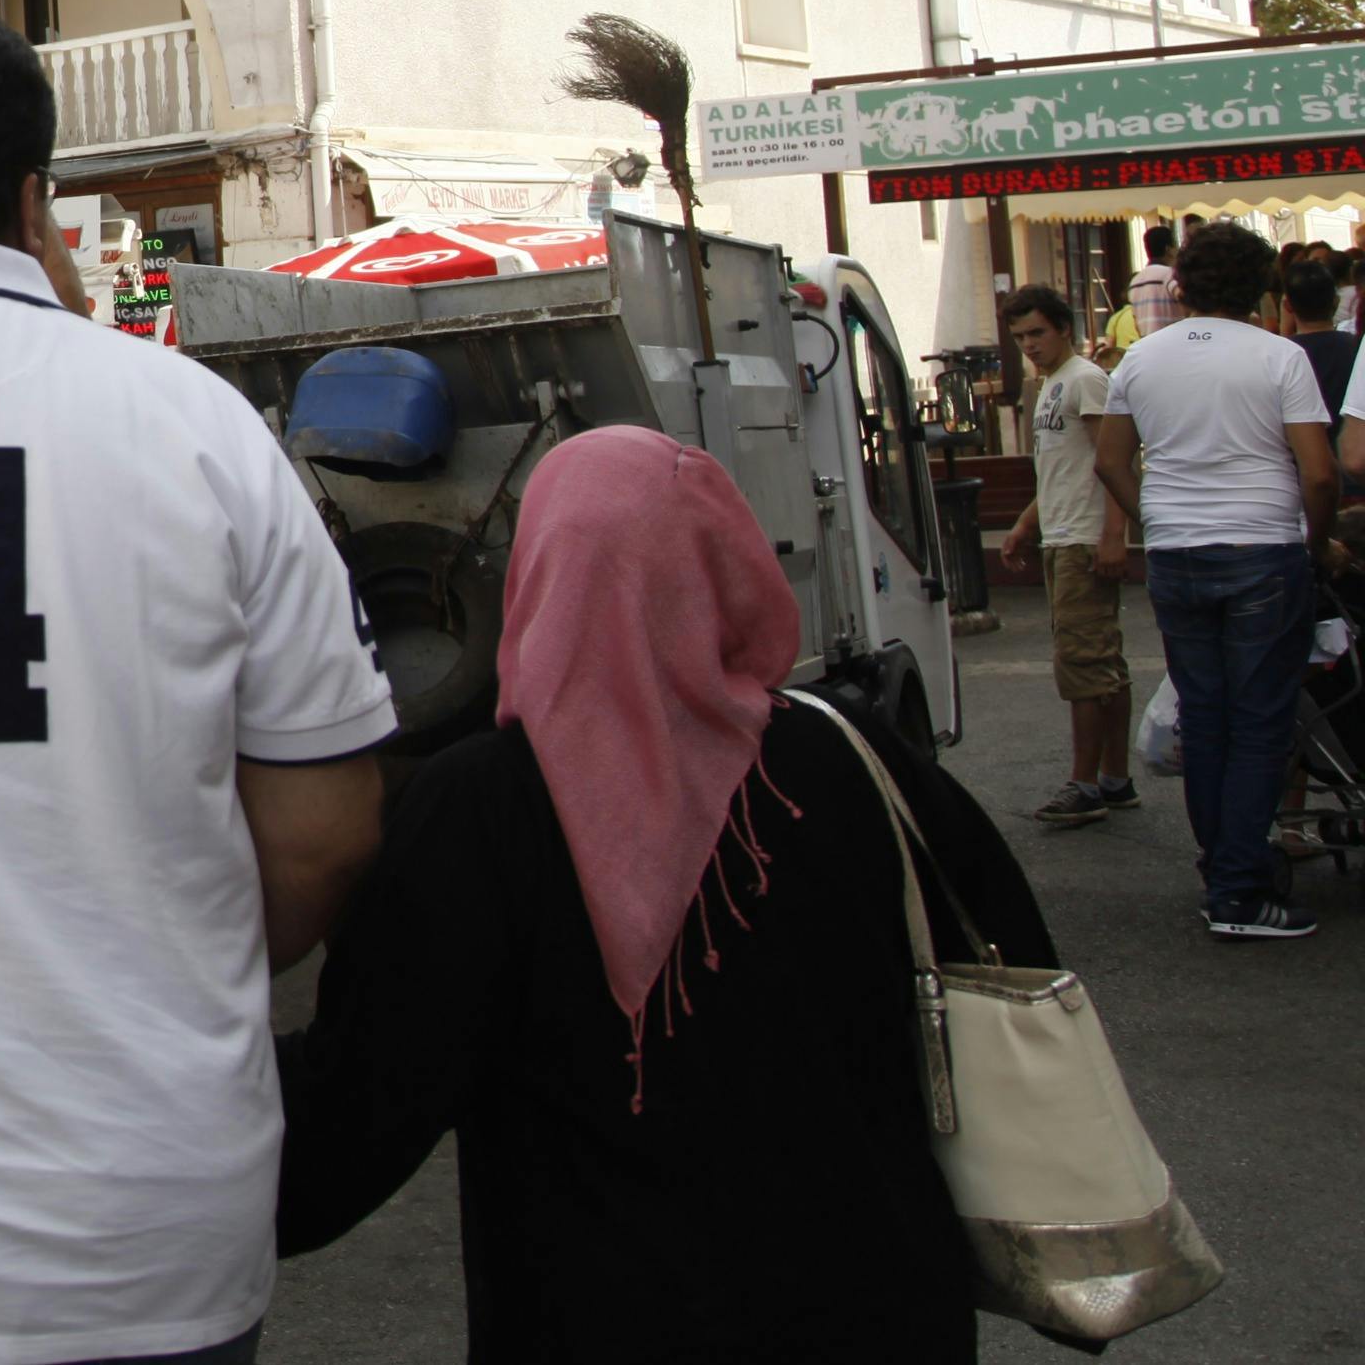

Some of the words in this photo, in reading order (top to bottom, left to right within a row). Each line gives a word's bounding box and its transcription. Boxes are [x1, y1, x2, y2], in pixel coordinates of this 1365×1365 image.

[707, 95, 844, 122] ADALAR
[709, 114, 844, 144] TURNİKESİ
[1053, 103, 1280, 148] phaeton
[711, 148, 738, 156] saat
[1118, 151, 1284, 186] PHAETON
[489, 186, 531, 209] MARKET
